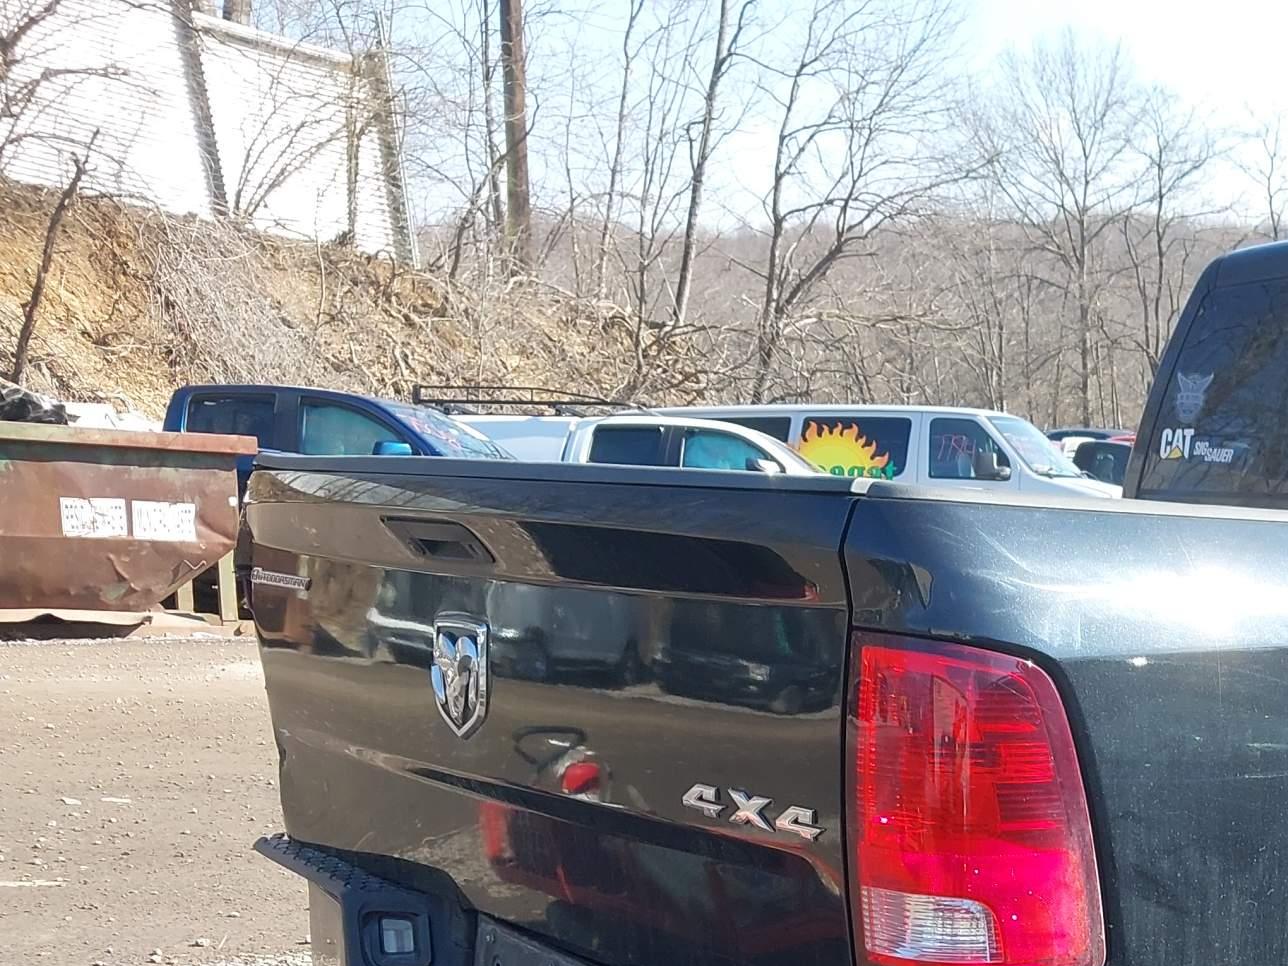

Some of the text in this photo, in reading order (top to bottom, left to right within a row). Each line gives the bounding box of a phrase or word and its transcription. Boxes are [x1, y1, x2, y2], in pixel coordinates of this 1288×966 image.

[1160, 428, 1195, 459] CAT
[1193, 441, 1234, 462] SIG SAUER
